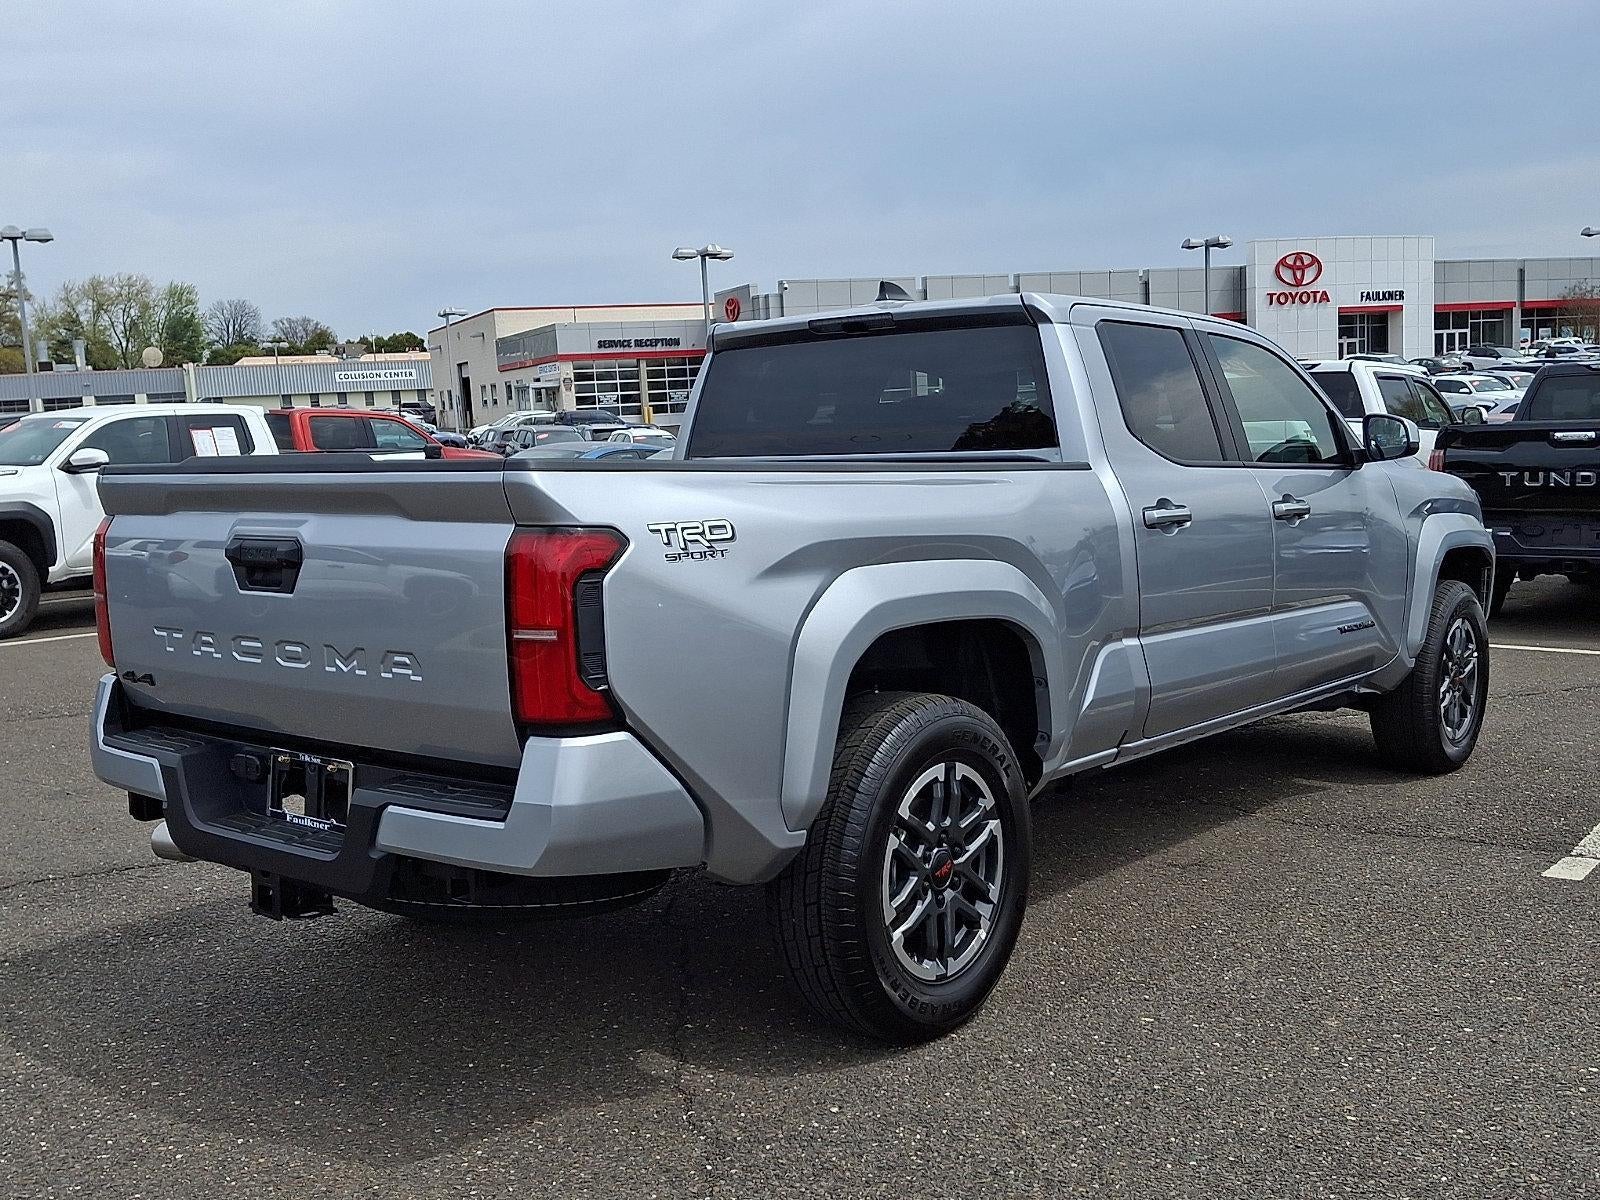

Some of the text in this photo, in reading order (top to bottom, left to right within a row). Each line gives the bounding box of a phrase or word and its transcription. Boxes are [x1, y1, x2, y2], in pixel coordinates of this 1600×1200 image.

[1266, 290, 1330, 306] TOYOTA
[1360, 290, 1404, 302] FAULKNER
[597, 337, 681, 349] SERVICE RECEPTION
[338, 372, 382, 380] COLLISION
[646, 519, 736, 551] TRD
[664, 549, 729, 563] SPORT
[153, 626, 423, 681] TACOMA
[952, 728, 1012, 779] GENERAL
[286, 814, 330, 830] Faulkner
